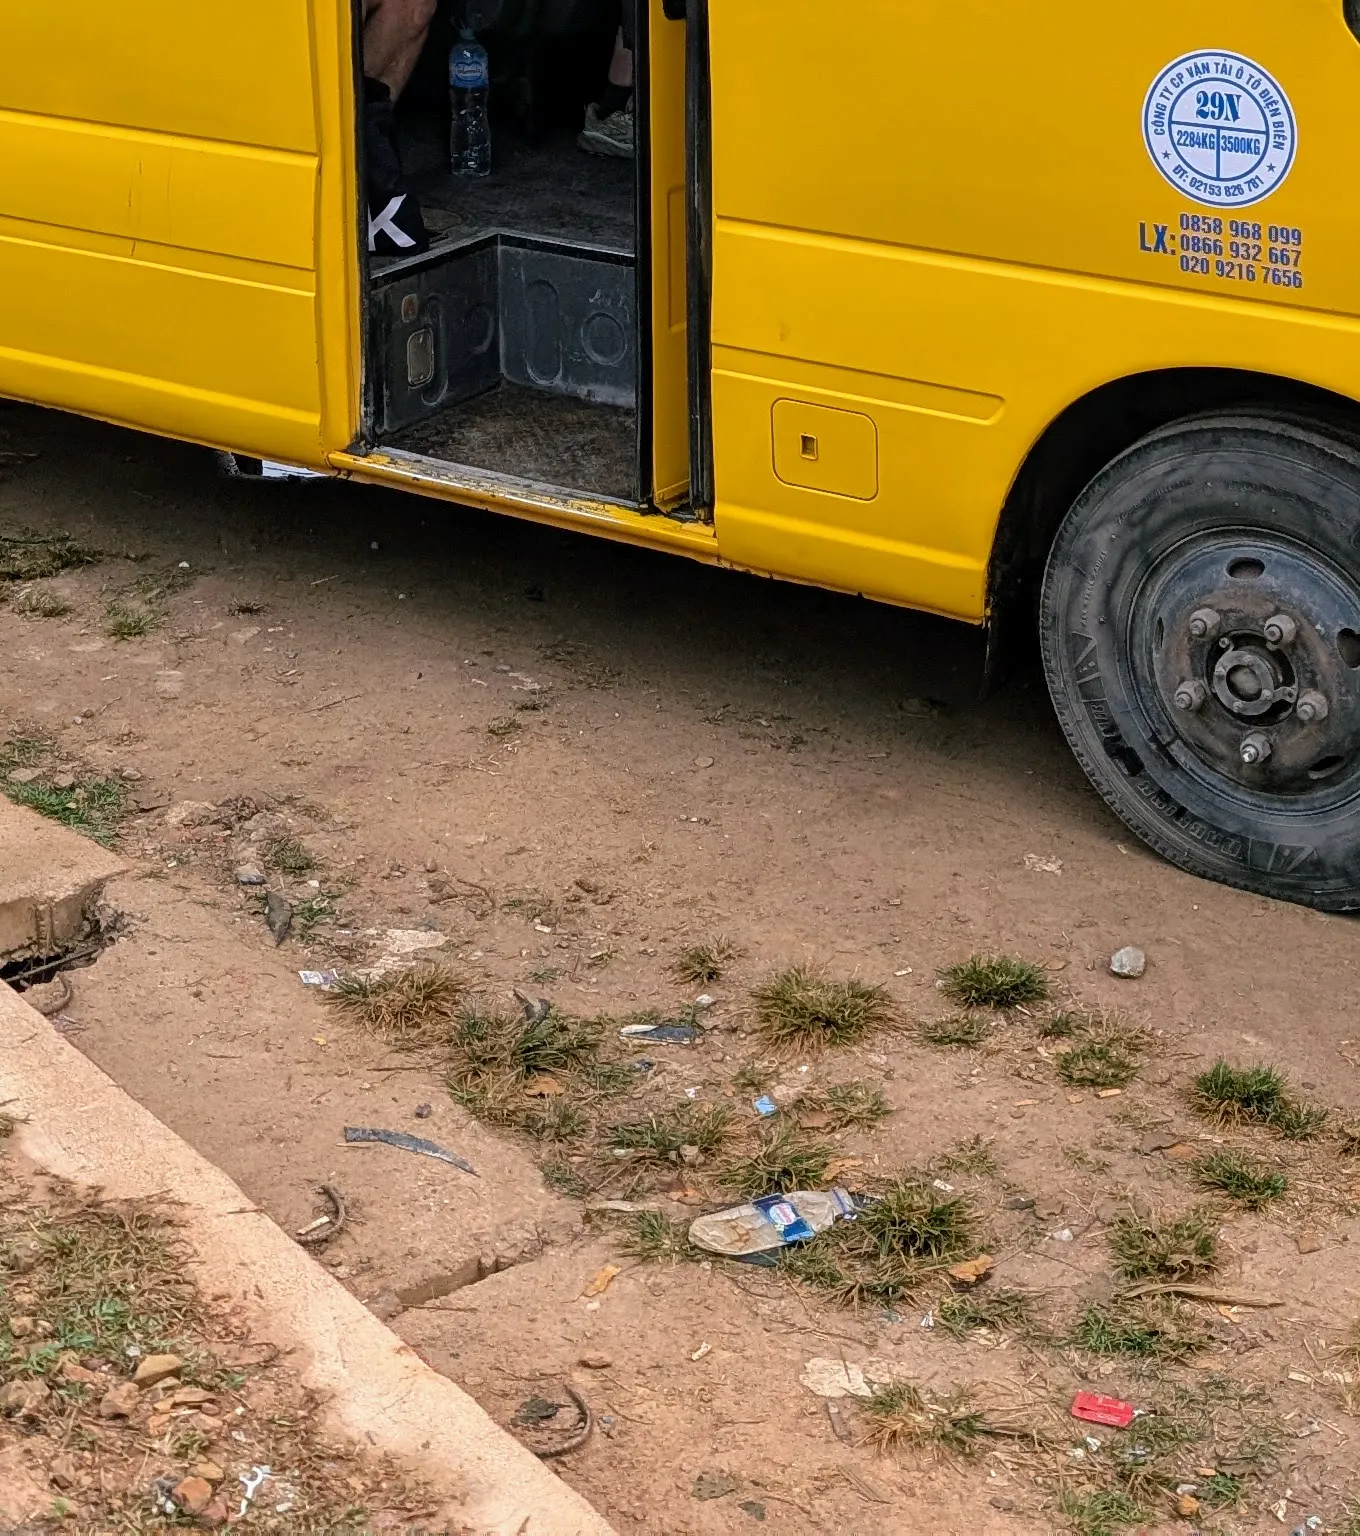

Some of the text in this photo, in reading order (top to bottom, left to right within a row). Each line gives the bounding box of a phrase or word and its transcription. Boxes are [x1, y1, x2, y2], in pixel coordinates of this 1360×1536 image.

[1150, 102, 1167, 136] CÔNG
[1159, 86, 1173, 101] TY
[1170, 72, 1185, 89] CP
[1185, 61, 1211, 79] VẬN
[1213, 58, 1232, 77] TẢI
[1235, 66, 1244, 80] Ô
[1245, 73, 1262, 91] TÔ
[1272, 120, 1288, 151] BIÊN
[1196, 90, 1242, 123] 29N
[1176, 130, 1216, 150] 2284KG
[1221, 135, 1261, 156] 3500KG
[1189, 176, 1222, 196] 02153
[1139, 221, 1176, 256] LX:
[1179, 212, 1302, 246] 0858 968 099
[1179, 233, 1302, 268] 0866 932 667
[1179, 254, 1303, 289] 020 9216 7656
